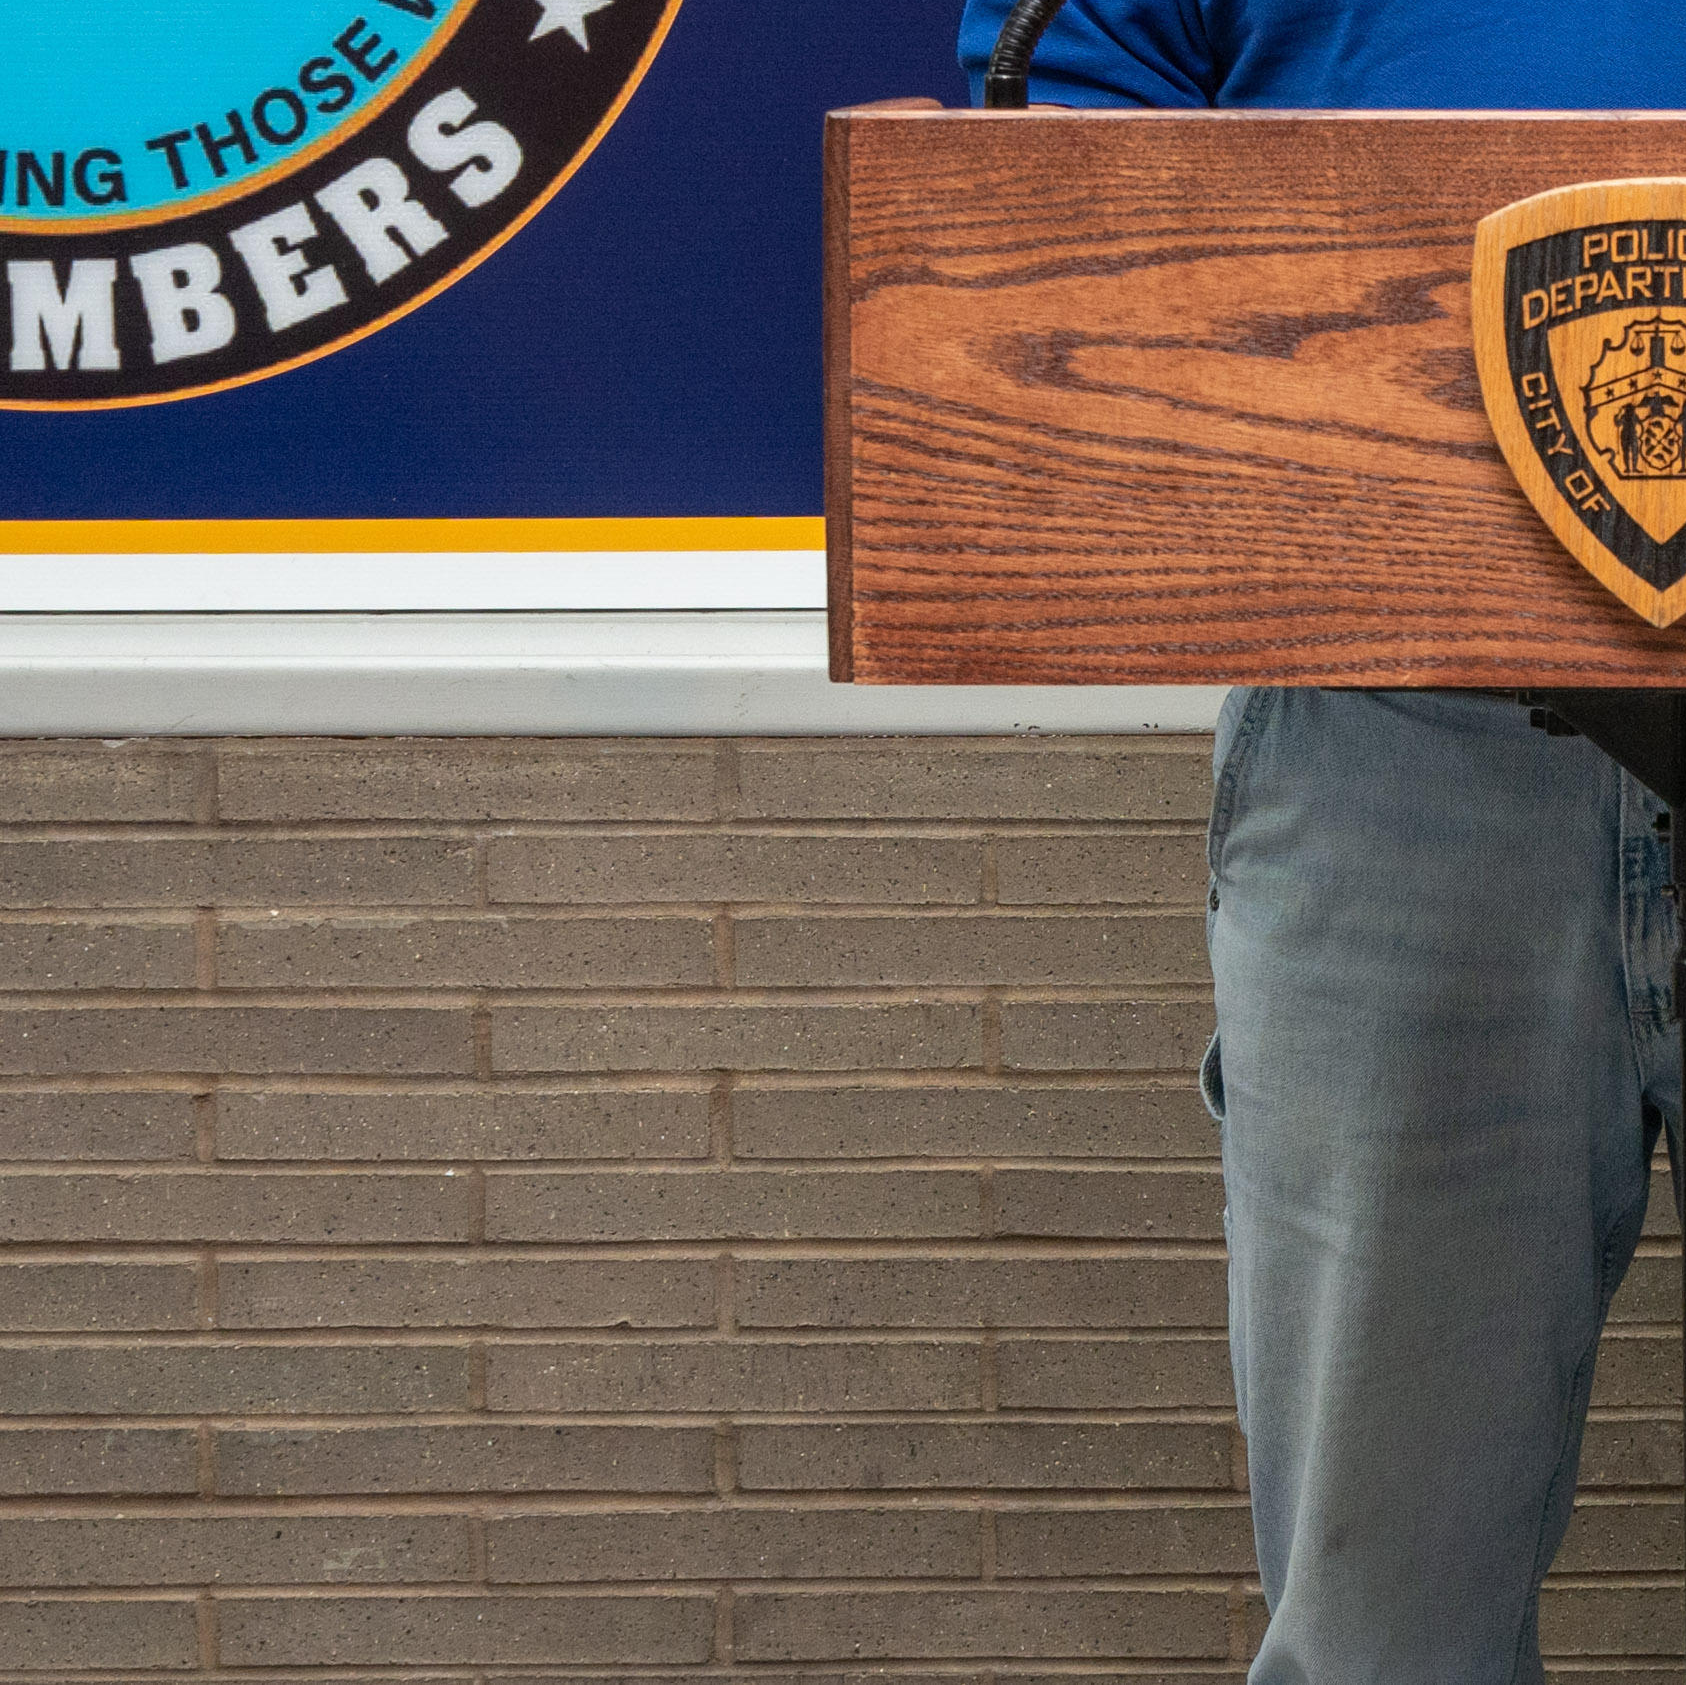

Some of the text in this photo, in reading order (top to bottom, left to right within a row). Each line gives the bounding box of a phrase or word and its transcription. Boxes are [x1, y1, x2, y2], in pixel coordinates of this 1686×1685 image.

[146, 17, 401, 191] THOSE
[7, 86, 525, 372] MBERS
[1521, 371, 1612, 514] CITY OF
